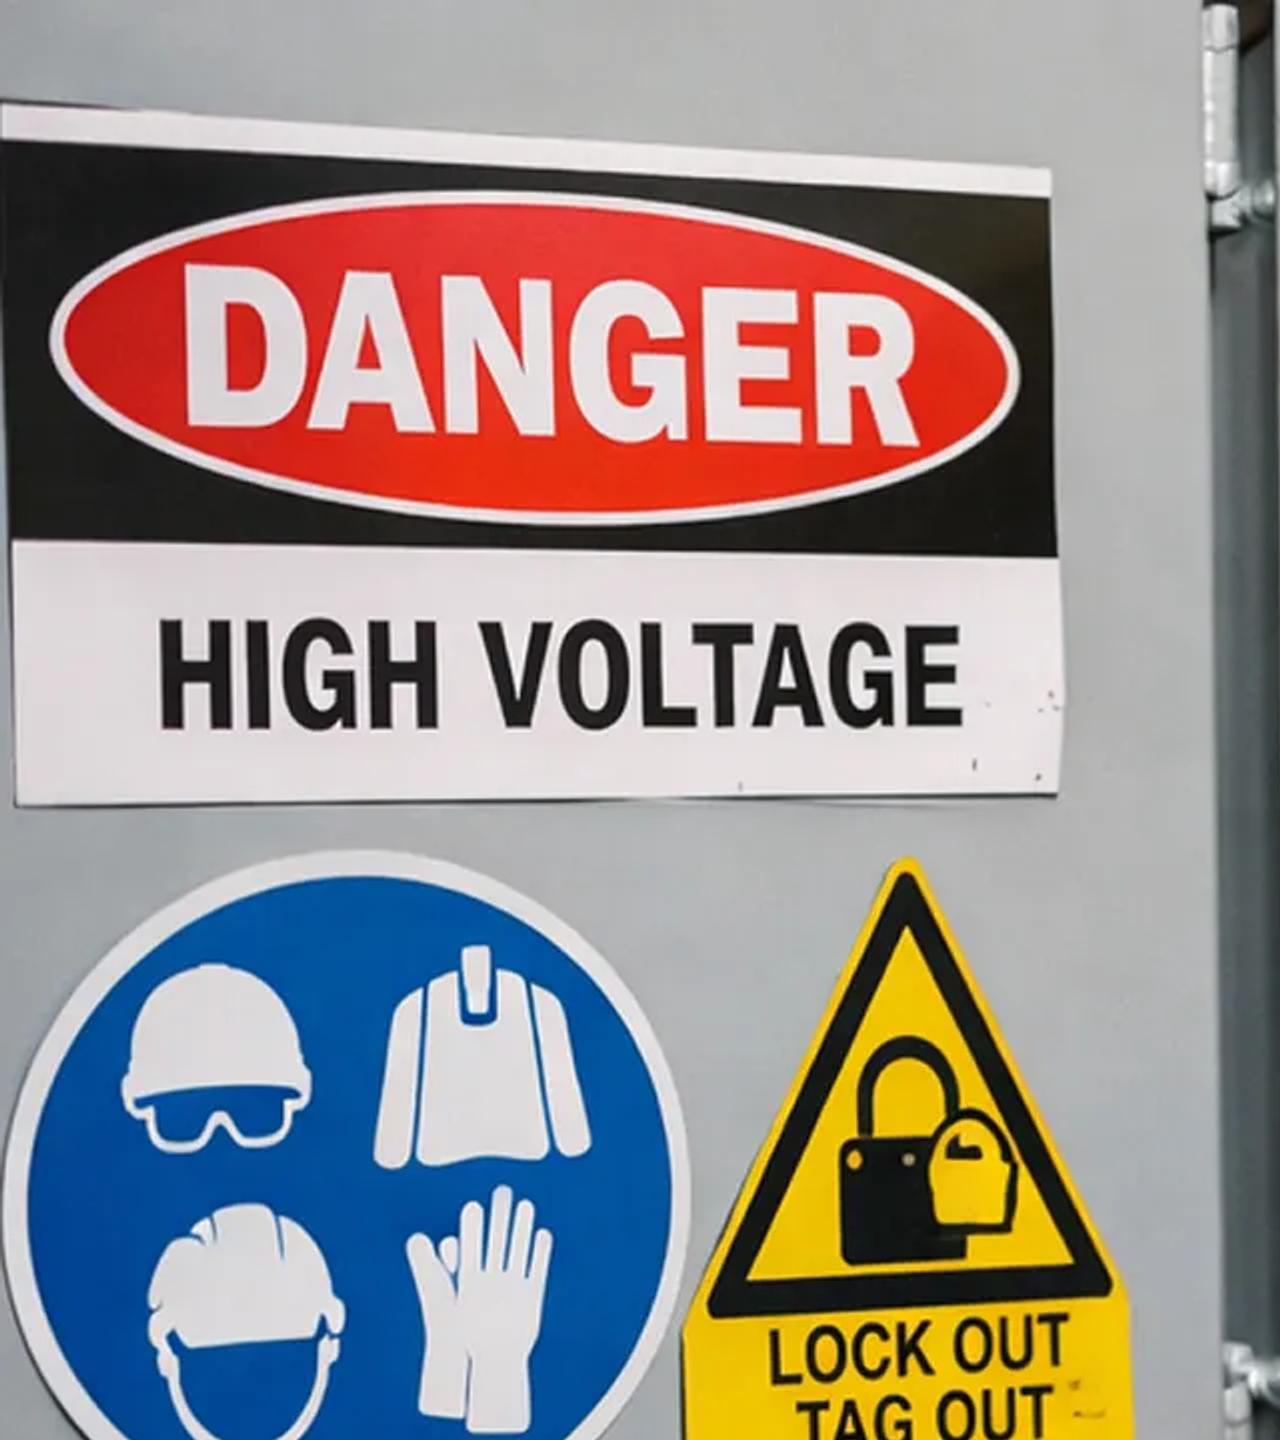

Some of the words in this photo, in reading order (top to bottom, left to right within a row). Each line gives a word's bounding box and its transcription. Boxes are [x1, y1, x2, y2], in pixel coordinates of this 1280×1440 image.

[185, 262, 919, 448] DANGER
[159, 619, 439, 729] HIGH
[478, 621, 962, 729] VOLTAGE
[769, 1320, 935, 1386] LOCK
[953, 1313, 1069, 1373] OUT
